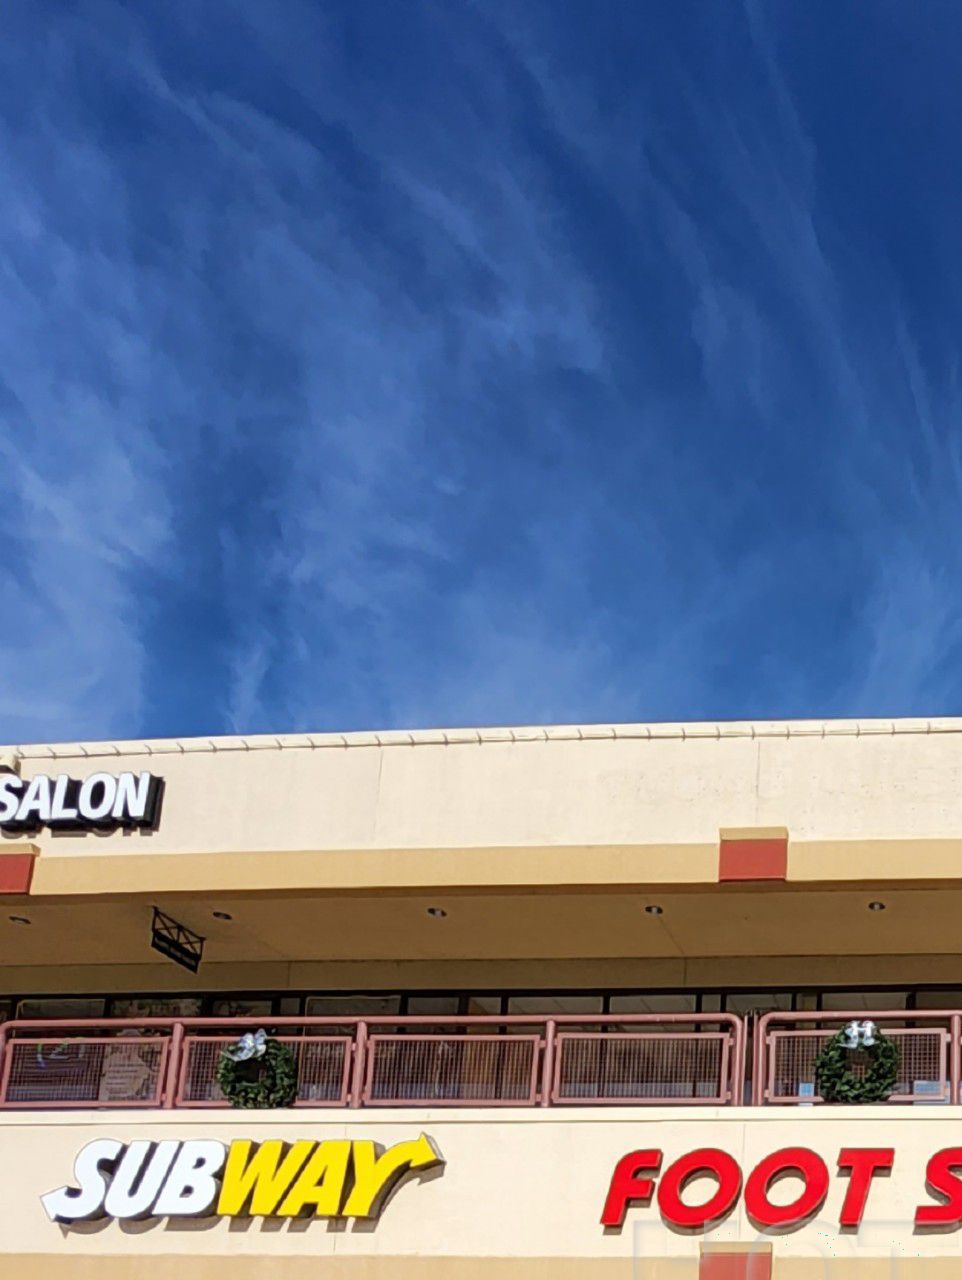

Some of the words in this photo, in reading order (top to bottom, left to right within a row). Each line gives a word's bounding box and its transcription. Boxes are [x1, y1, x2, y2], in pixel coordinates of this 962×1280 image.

[0, 771, 154, 823] SALON
[40, 1132, 445, 1223] SUBWAY
[600, 1146, 895, 1230] FOOT
